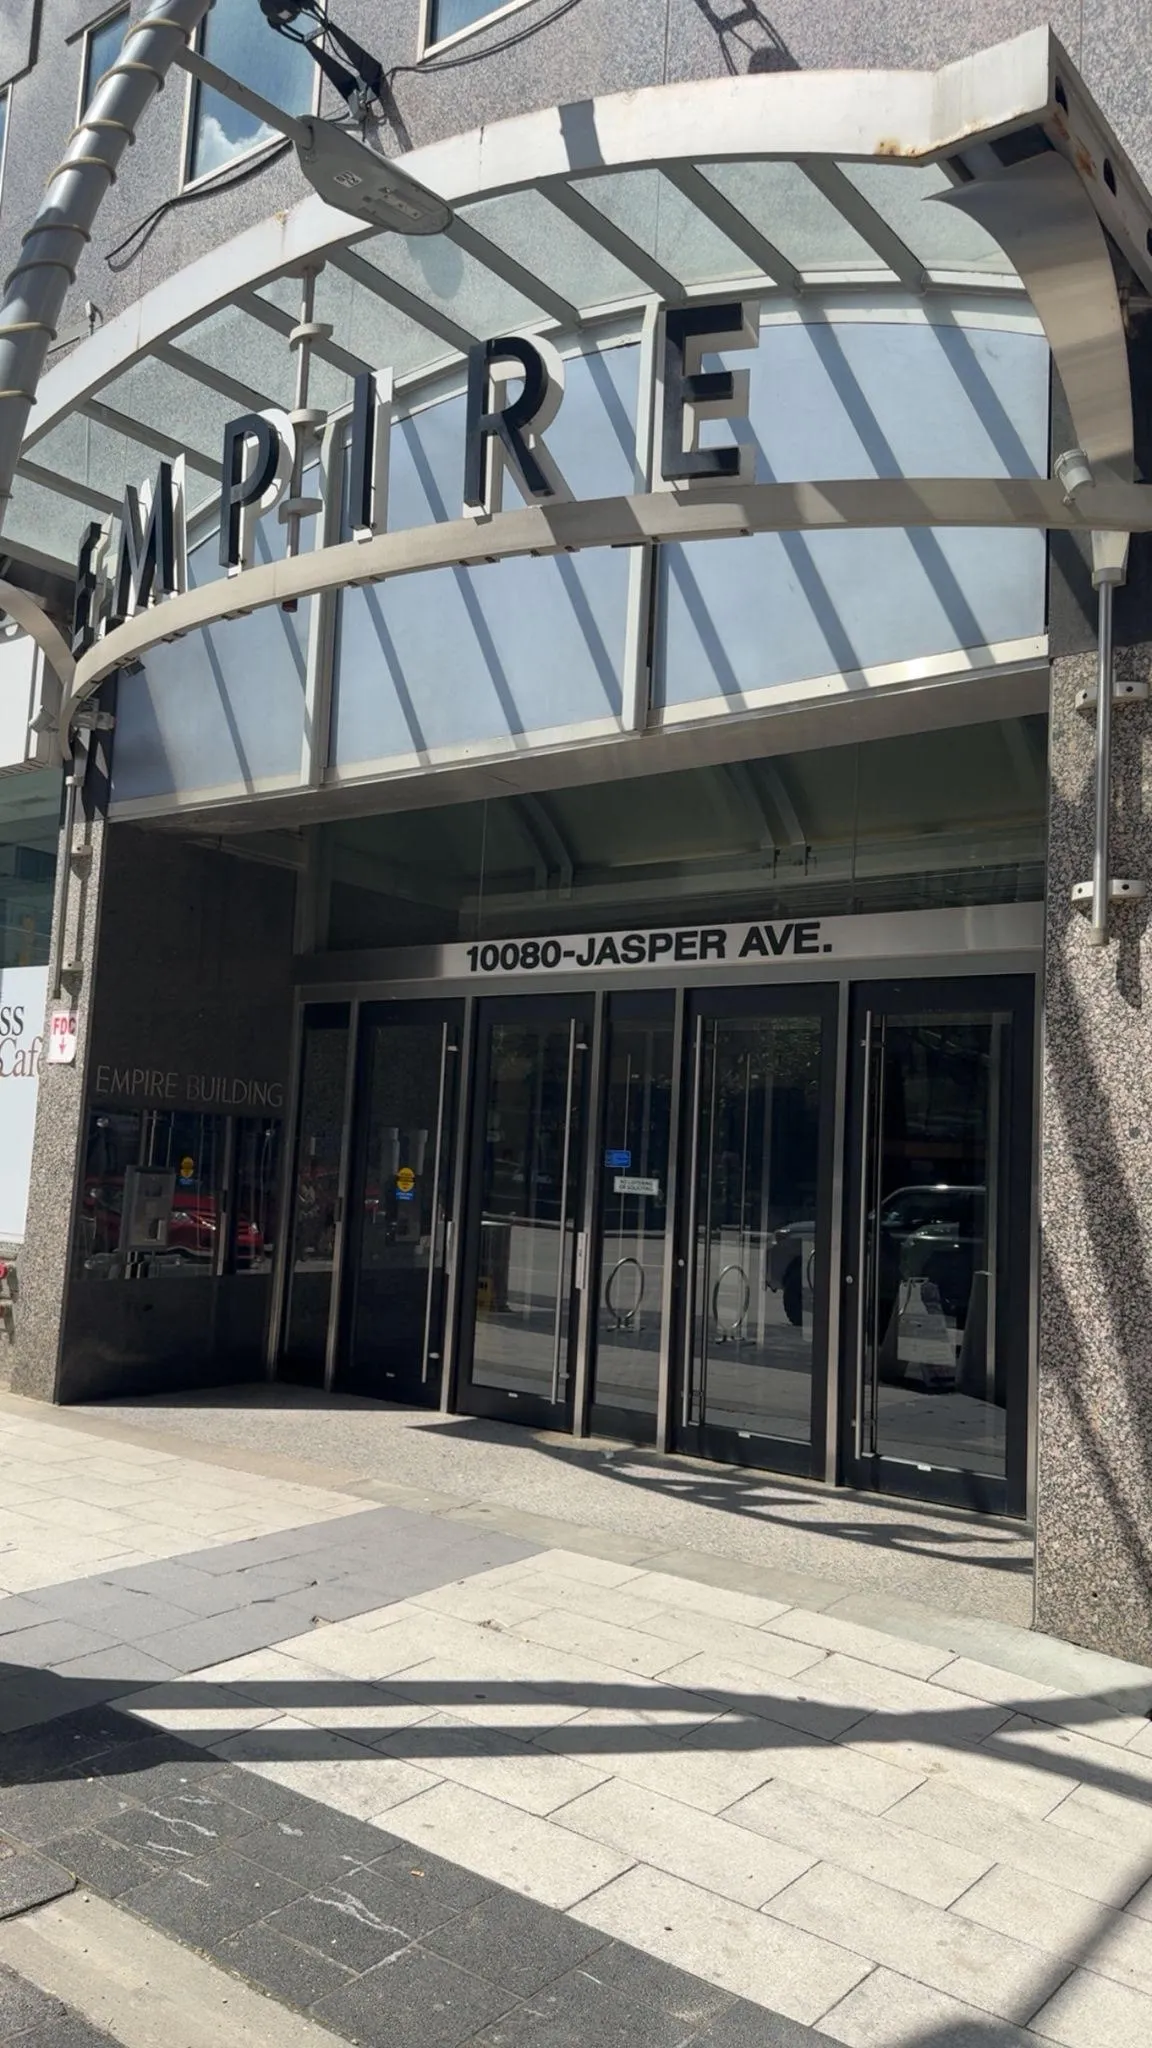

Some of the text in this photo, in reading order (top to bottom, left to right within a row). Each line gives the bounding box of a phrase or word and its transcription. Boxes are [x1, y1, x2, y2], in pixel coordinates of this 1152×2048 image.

[71, 301, 760, 660] EMPIRE
[466, 921, 833, 973] 10080-JASPER AVE.
[52, 1016, 77, 1036] FDC
[95, 1064, 284, 1108] EMPIRE BUILDING
